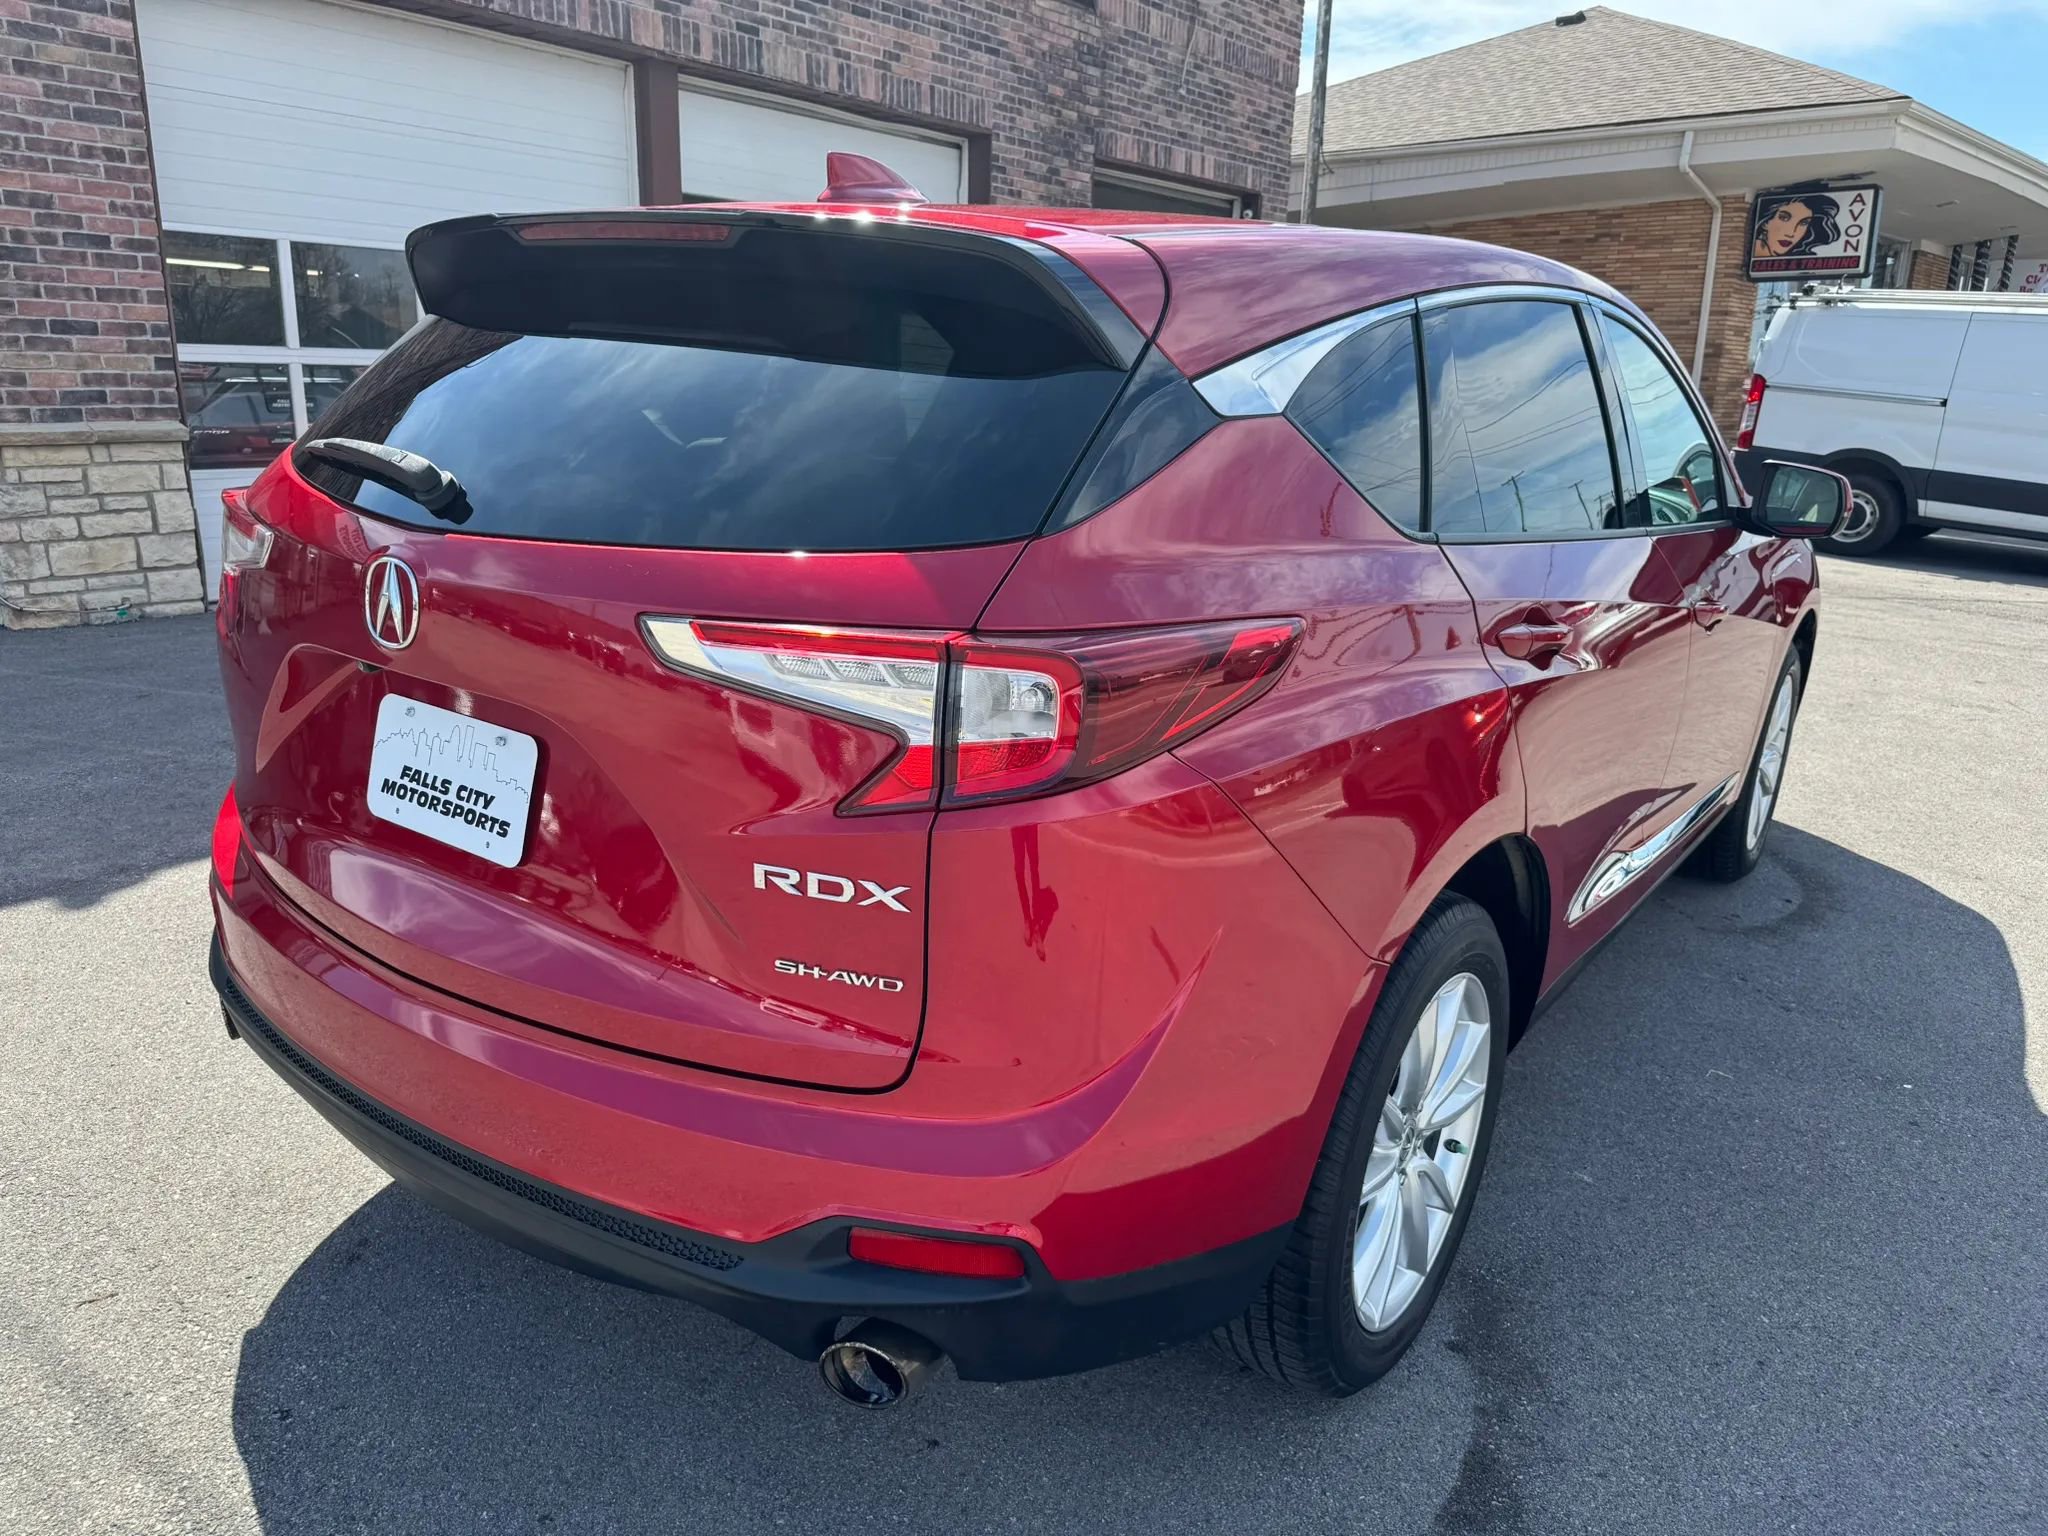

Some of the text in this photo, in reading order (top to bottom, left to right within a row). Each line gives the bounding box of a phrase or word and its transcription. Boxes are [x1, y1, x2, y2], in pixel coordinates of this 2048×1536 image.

[1843, 192, 1866, 253] AVON
[1753, 256, 1859, 272] SALES & TRAINING
[380, 777, 511, 839] MOTORSPORTS
[399, 764, 497, 810] FALLS CITY
[753, 862, 912, 913] RDX
[774, 959, 904, 992] SH-AWD
